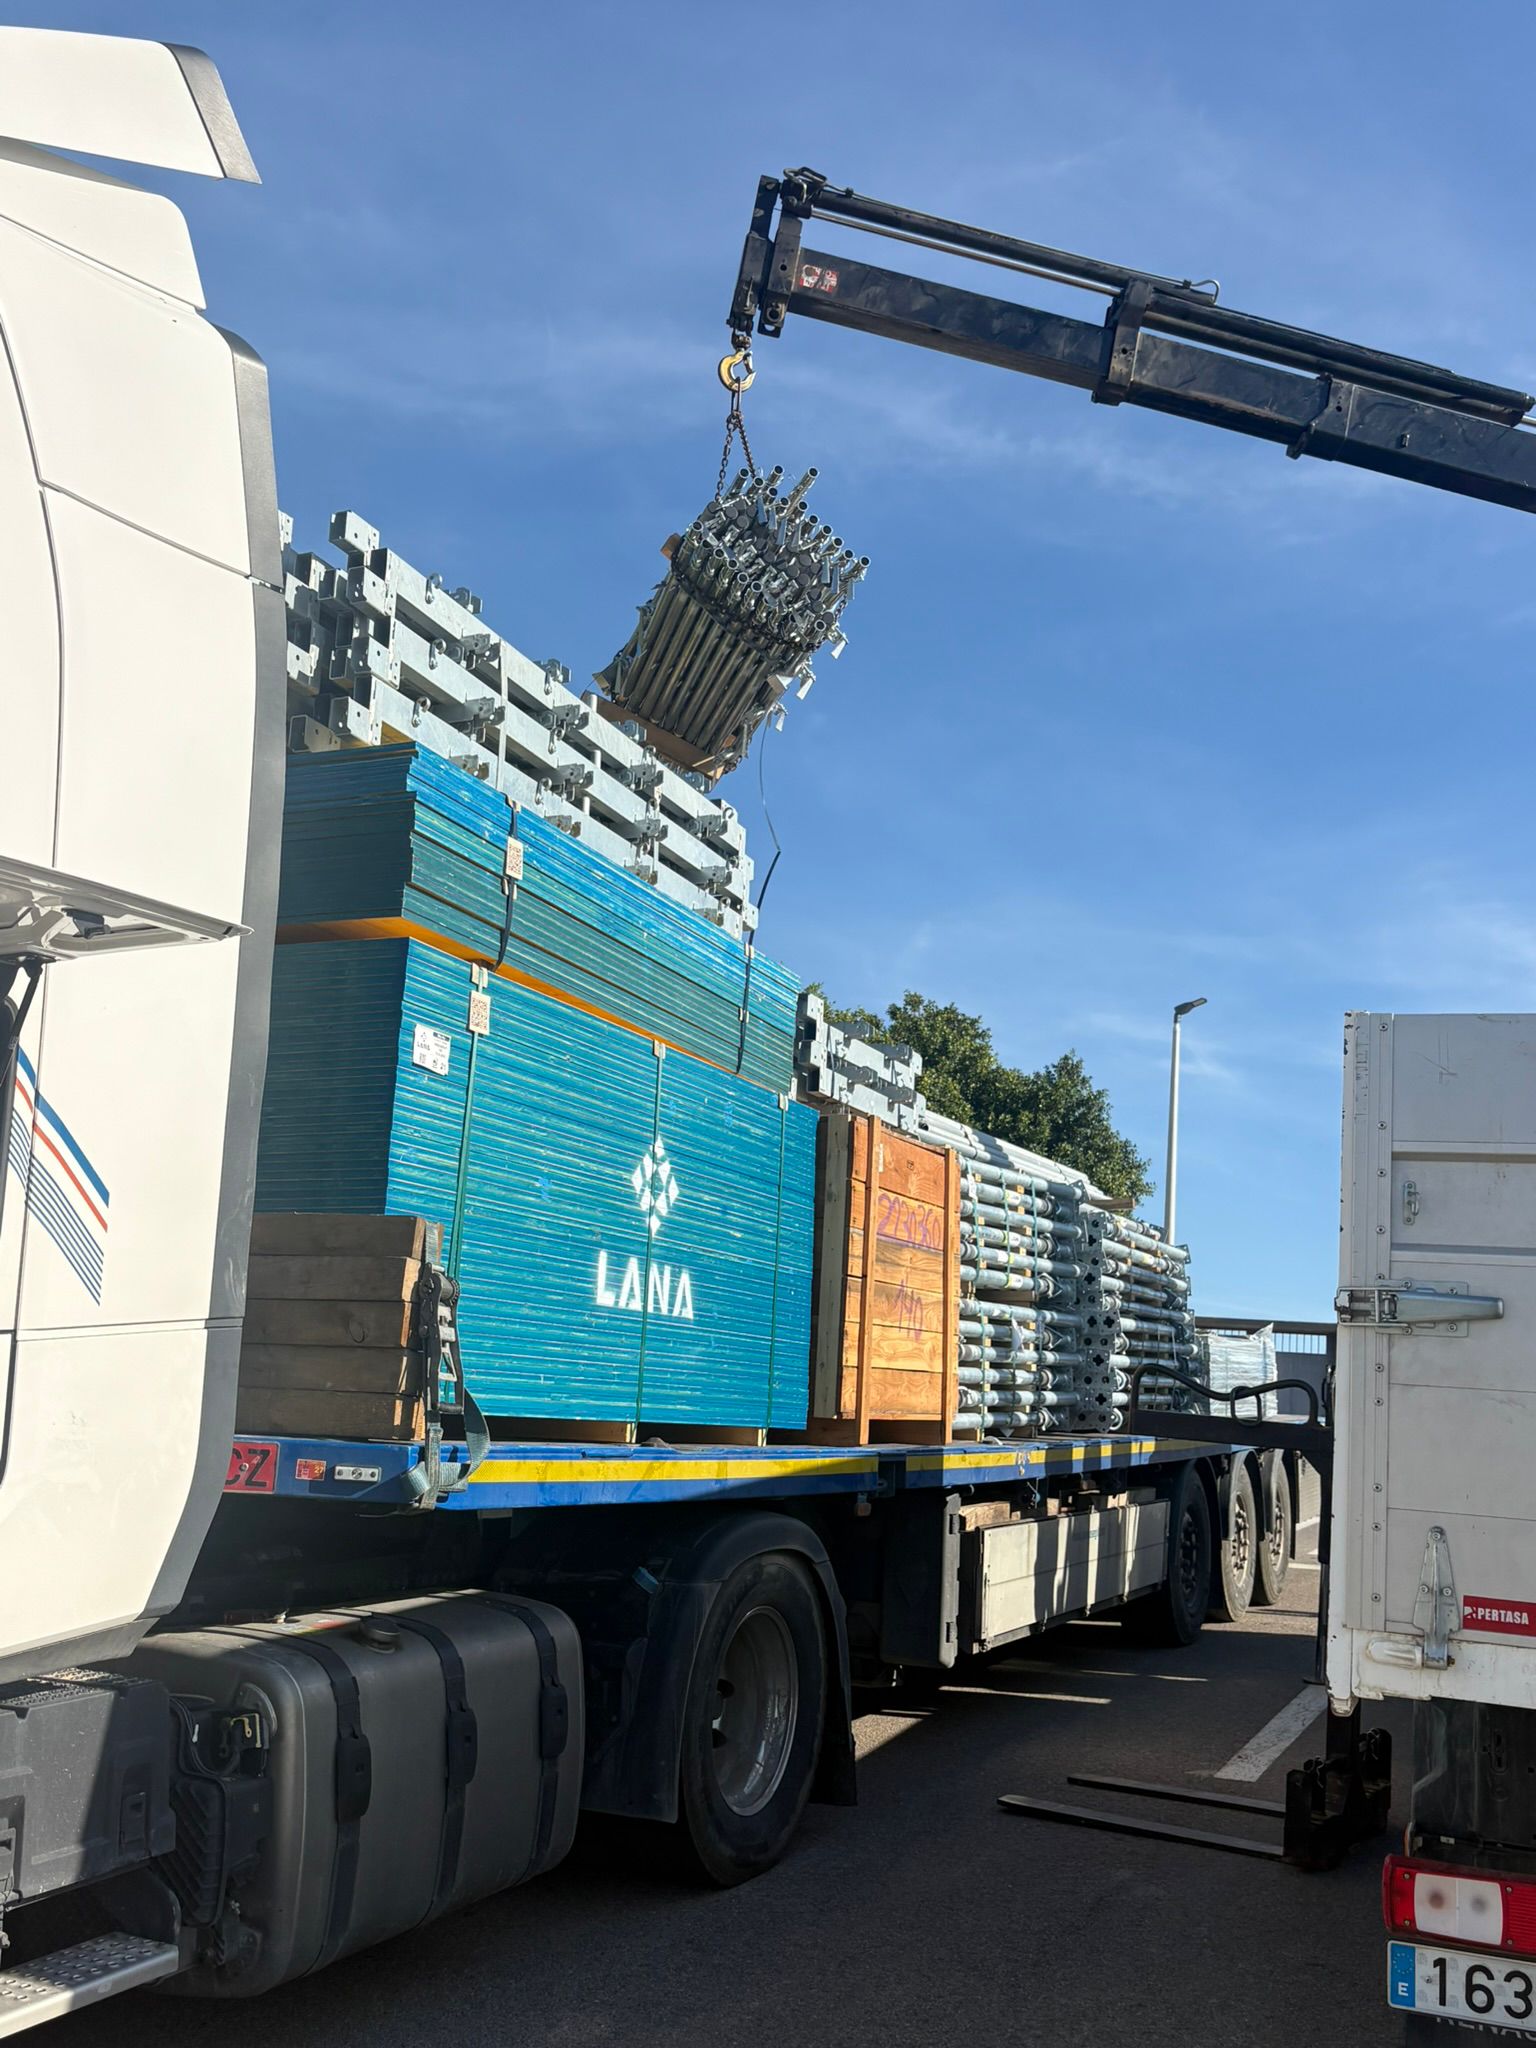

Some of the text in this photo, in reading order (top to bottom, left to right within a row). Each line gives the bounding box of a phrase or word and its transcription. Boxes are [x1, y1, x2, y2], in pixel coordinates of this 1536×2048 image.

[596, 1249, 694, 1319] LANA
[1477, 1607, 1529, 1625] PERTASA
[1398, 1956, 1533, 2020] E 163
